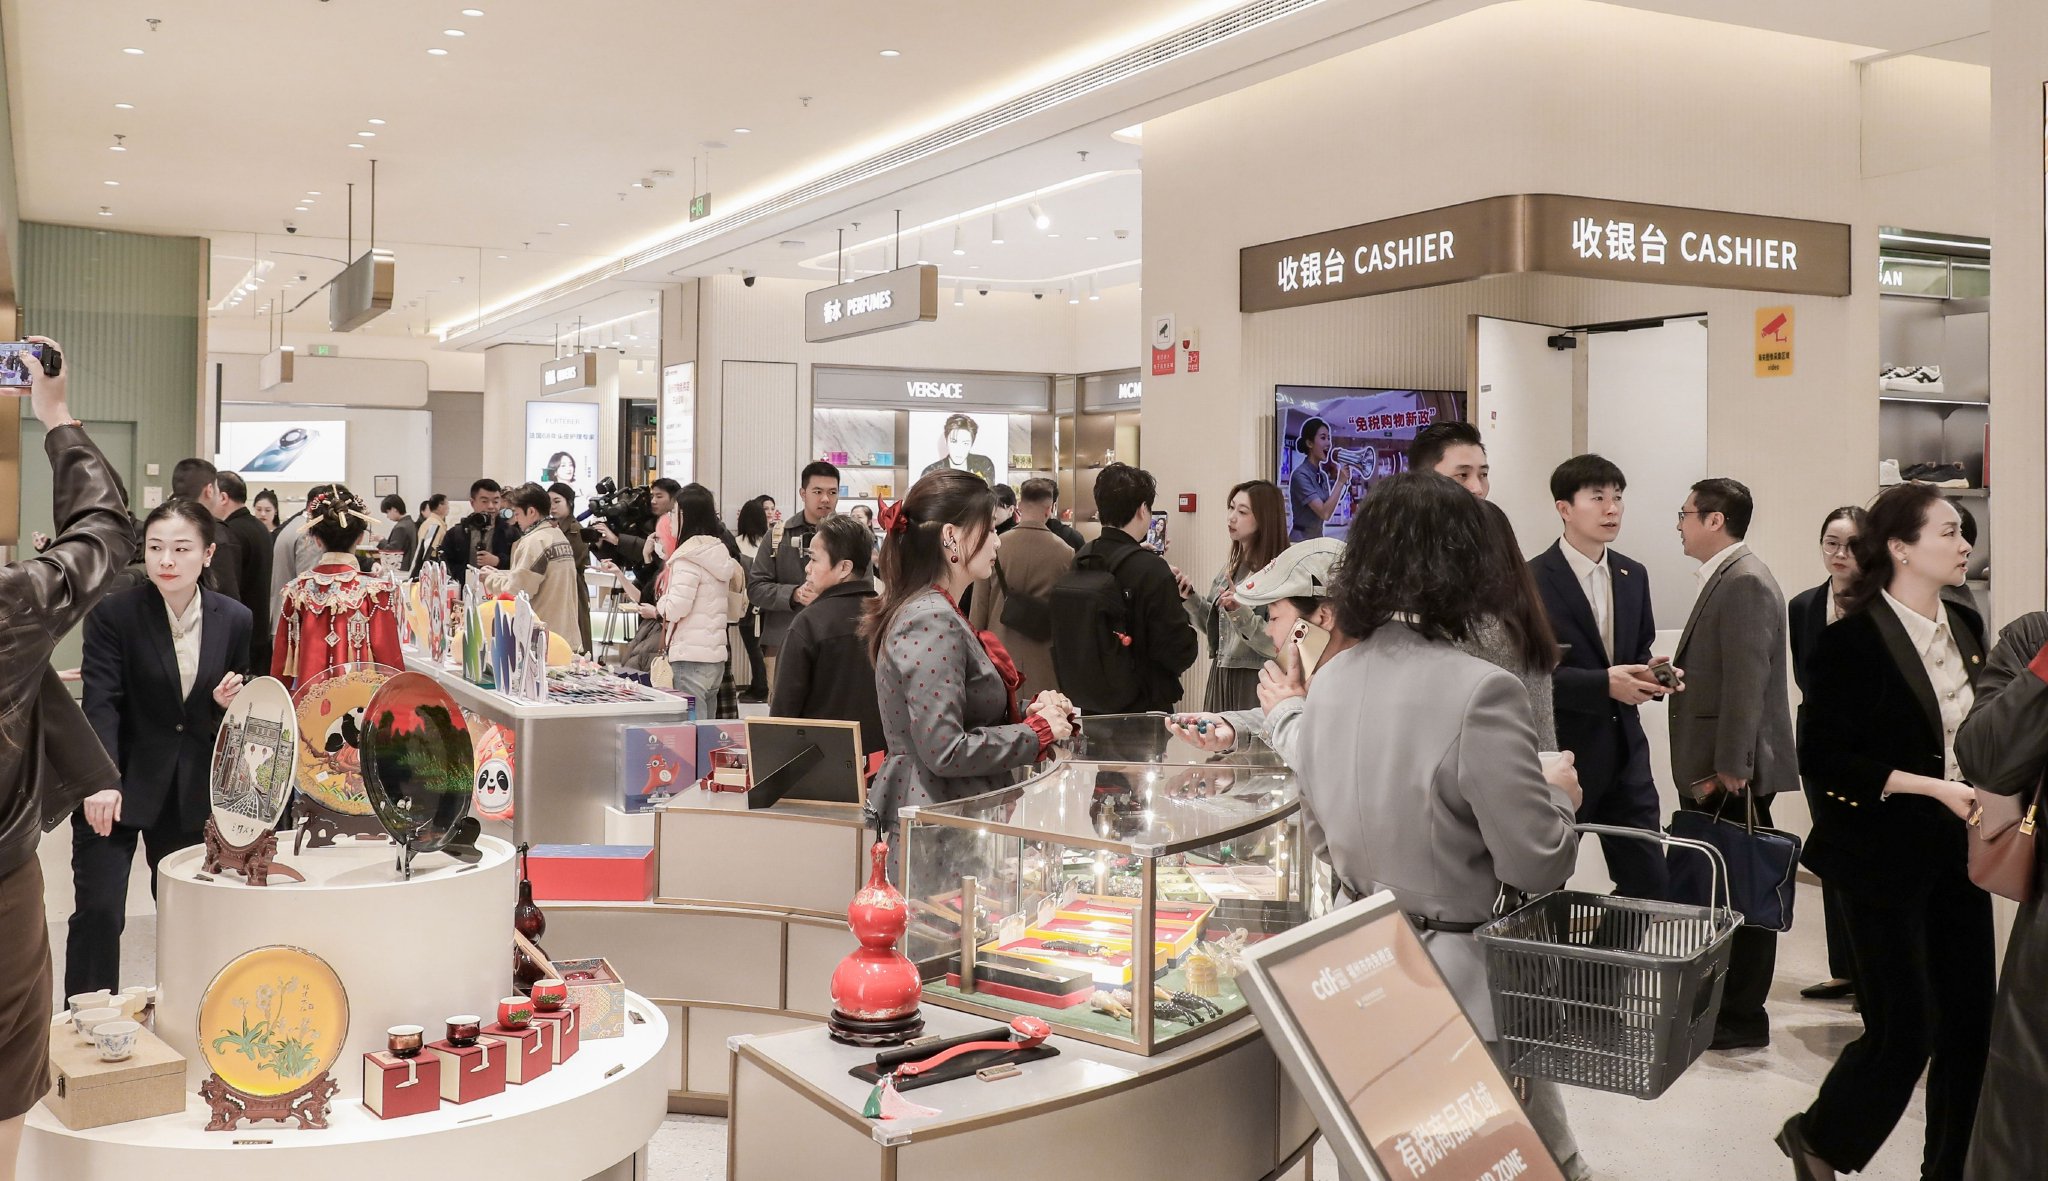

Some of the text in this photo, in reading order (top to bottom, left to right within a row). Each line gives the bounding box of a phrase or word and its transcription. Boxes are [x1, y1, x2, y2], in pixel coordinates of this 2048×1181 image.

[1572, 217, 1798, 270] 收银台 CASHIER
[1278, 231, 1455, 292] 收银台 CASHIER
[846, 290, 892, 317] PERFUMES
[906, 381, 963, 399] VERSACE
[1118, 381, 1142, 399] MCM
[1311, 966, 1340, 1000] cdf
[1394, 1080, 1502, 1179] 有税商品区域
[1491, 1147, 1528, 1181] ZONE
